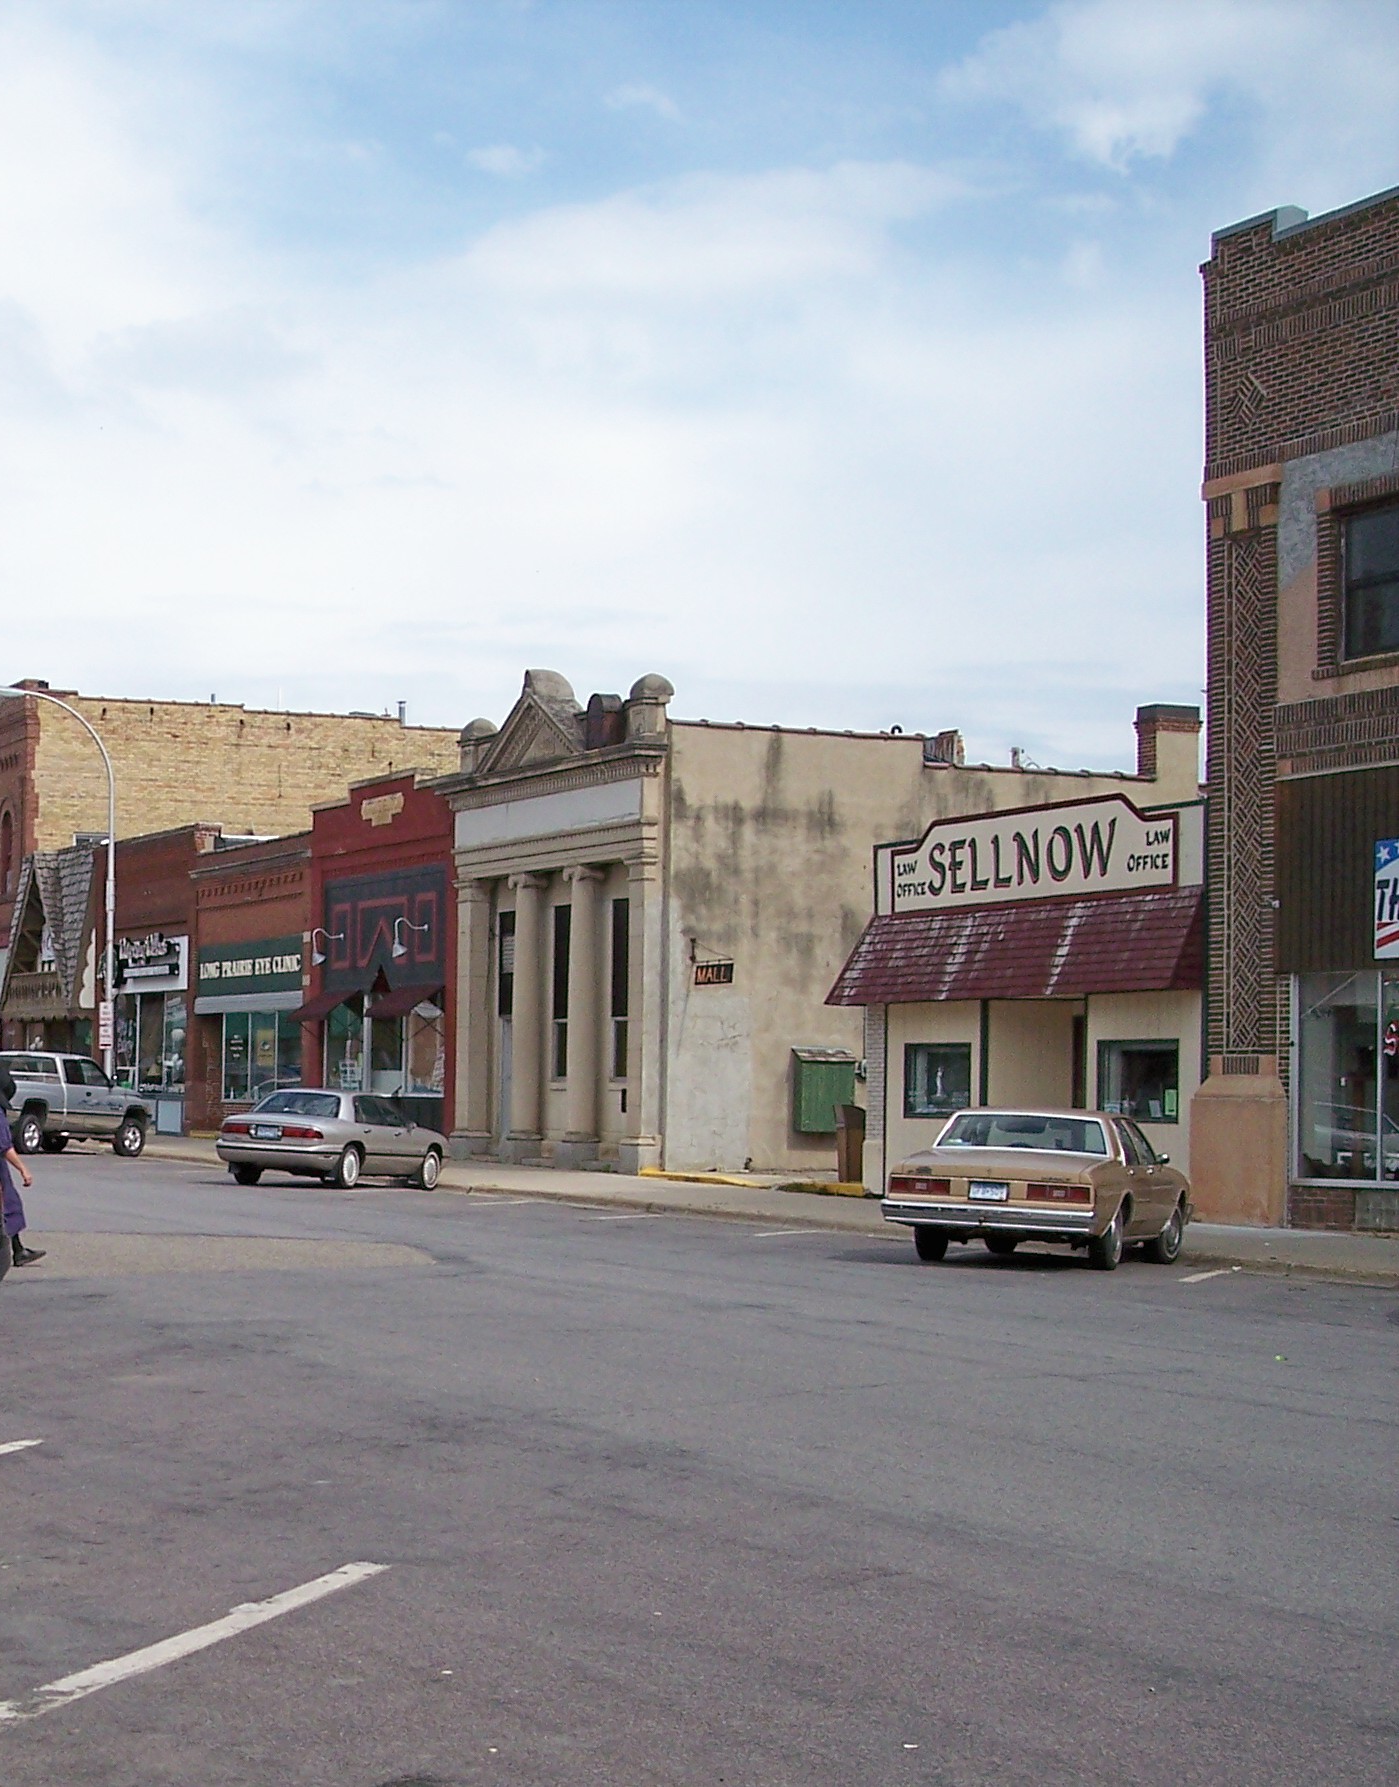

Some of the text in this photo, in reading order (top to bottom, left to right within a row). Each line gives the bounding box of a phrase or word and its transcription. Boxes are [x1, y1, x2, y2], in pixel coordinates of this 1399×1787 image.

[1145, 828, 1171, 847] LAW
[928, 817, 1117, 896] SELLNOW
[1126, 853, 1169, 872] OFFICE
[897, 860, 918, 877] LAW
[896, 881, 928, 898] OFFICE
[200, 954, 302, 979] LONG PRAIRIE EYE CLINIC
[696, 966, 728, 983] MALL
